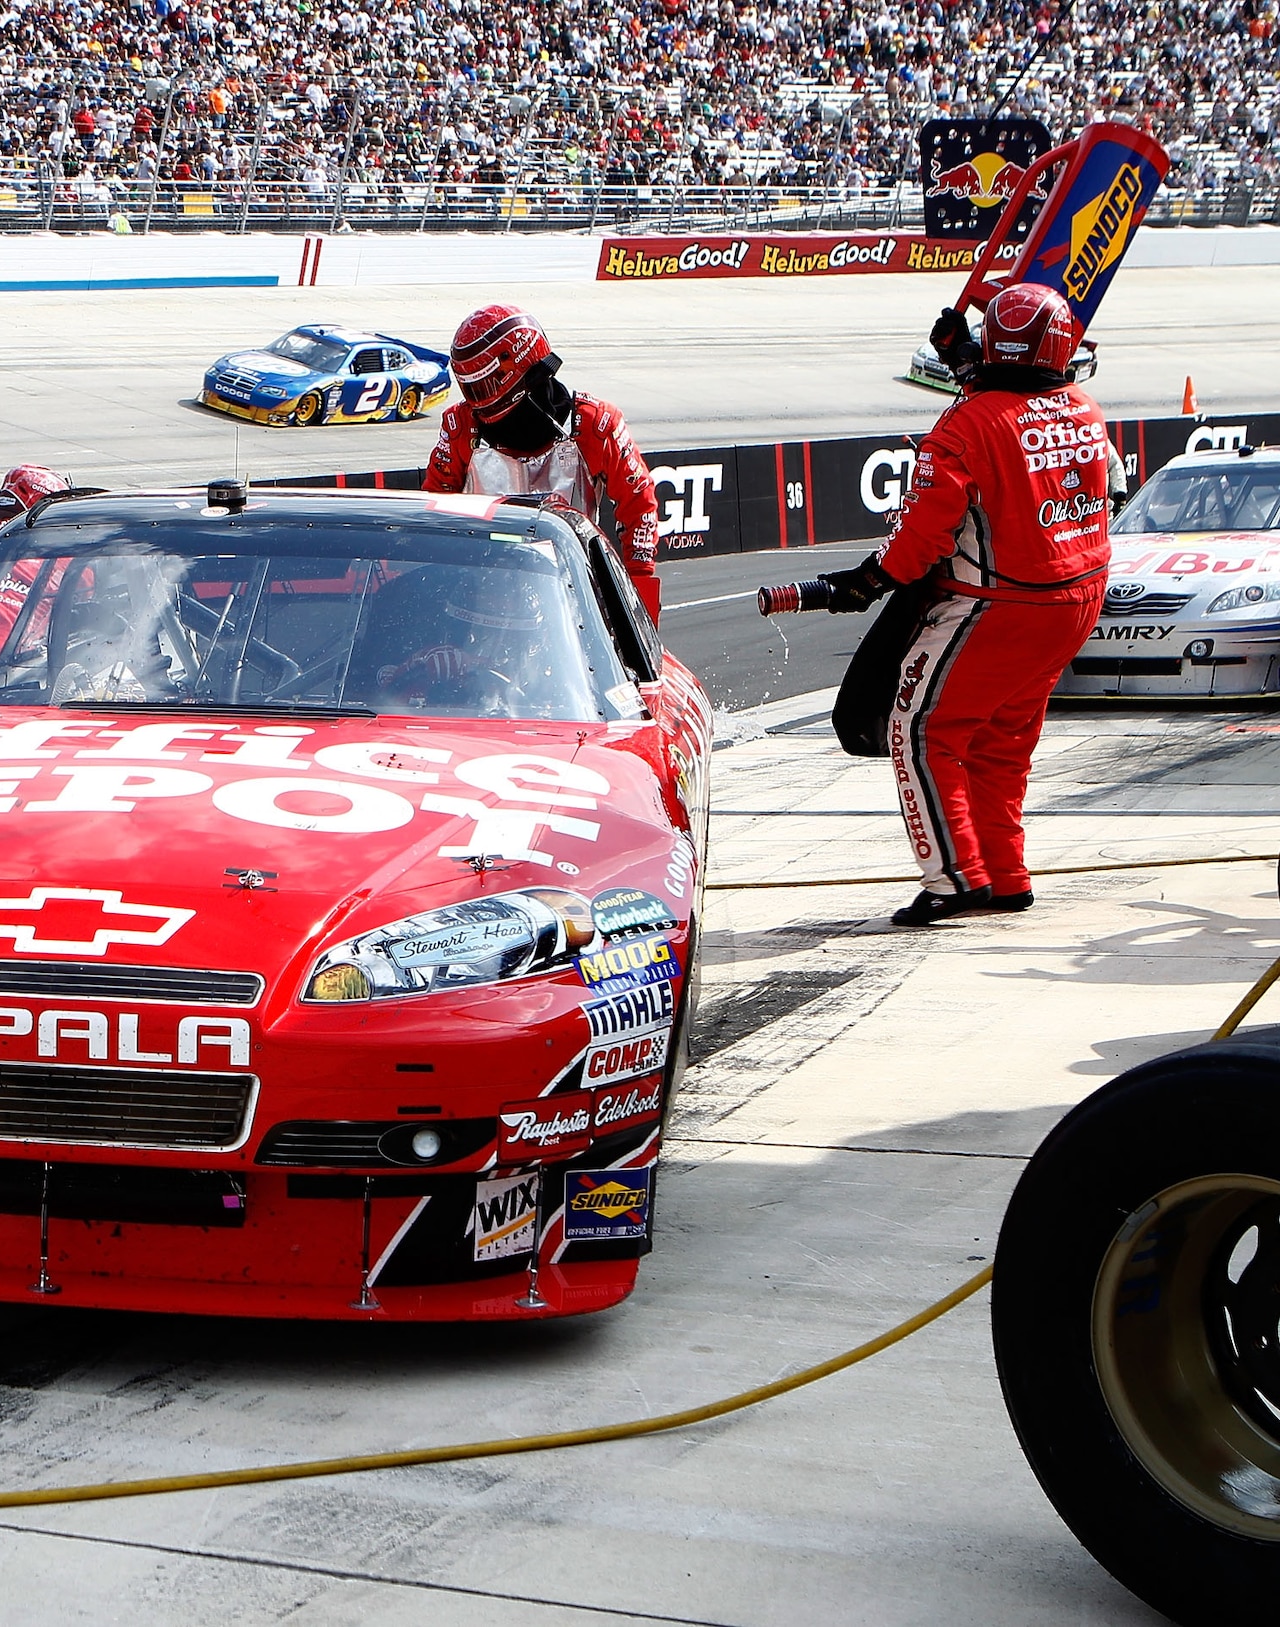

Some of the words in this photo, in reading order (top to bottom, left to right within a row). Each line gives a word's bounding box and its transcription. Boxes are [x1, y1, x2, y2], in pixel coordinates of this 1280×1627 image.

[1066, 166, 1141, 299] SUNOCO
[215, 382, 253, 401] DODGE
[353, 374, 388, 413] 2
[1020, 421, 1104, 452] Office
[1025, 441, 1107, 474] DEPOT
[1125, 453, 1138, 477] 37
[649, 463, 723, 538] GT
[786, 481, 804, 510] 36
[1038, 499, 1070, 527] Old
[1069, 493, 1105, 522] Spice
[664, 533, 705, 550] VODKA
[1088, 625, 1177, 641] AMRY
[891, 719, 911, 784] DEPOT
[903, 788, 932, 859] Office
[593, 891, 646, 911] GOODYEAR
[594, 900, 670, 933] Gatorback
[399, 931, 472, 959] Stewart
[482, 923, 524, 940] Haas
[610, 919, 674, 945] BELTS
[579, 935, 671, 985] MOOG
[593, 973, 642, 998] CHASSIS
[644, 962, 676, 982] PARTS
[588, 983, 674, 1037] MAHLE
[588, 1038, 653, 1079] COMP
[632, 1056, 660, 1073] CAMS
[594, 1084, 661, 1127] Edelbrock
[505, 1106, 591, 1146] Raybestos
[478, 1177, 538, 1235] WIX
[573, 1191, 646, 1209] SUNOCO
[477, 1221, 537, 1259] FILTERS
